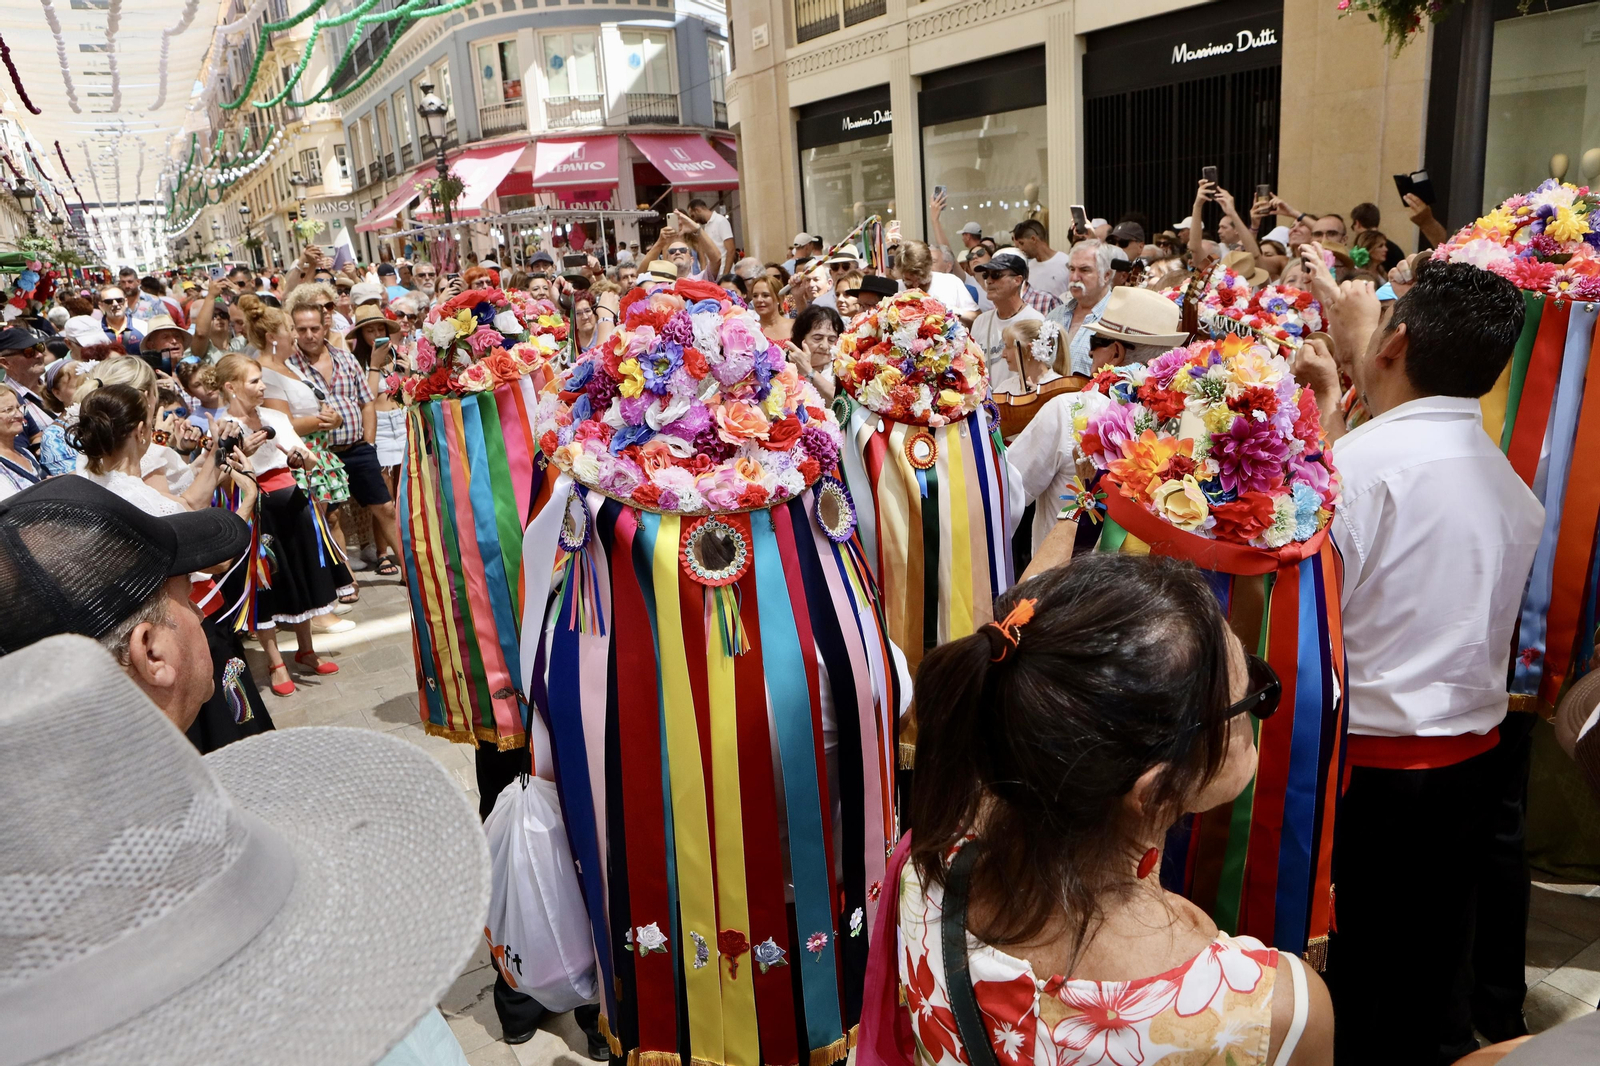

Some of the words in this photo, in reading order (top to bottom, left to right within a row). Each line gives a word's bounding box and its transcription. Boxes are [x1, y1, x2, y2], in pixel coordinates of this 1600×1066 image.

[1171, 43, 1234, 64] Massimo
[1236, 28, 1278, 52] Dutti
[842, 116, 873, 131] Massimo
[547, 161, 606, 173] LEPANTO
[664, 159, 716, 171] LEPANTO
[505, 944, 523, 977] ft
